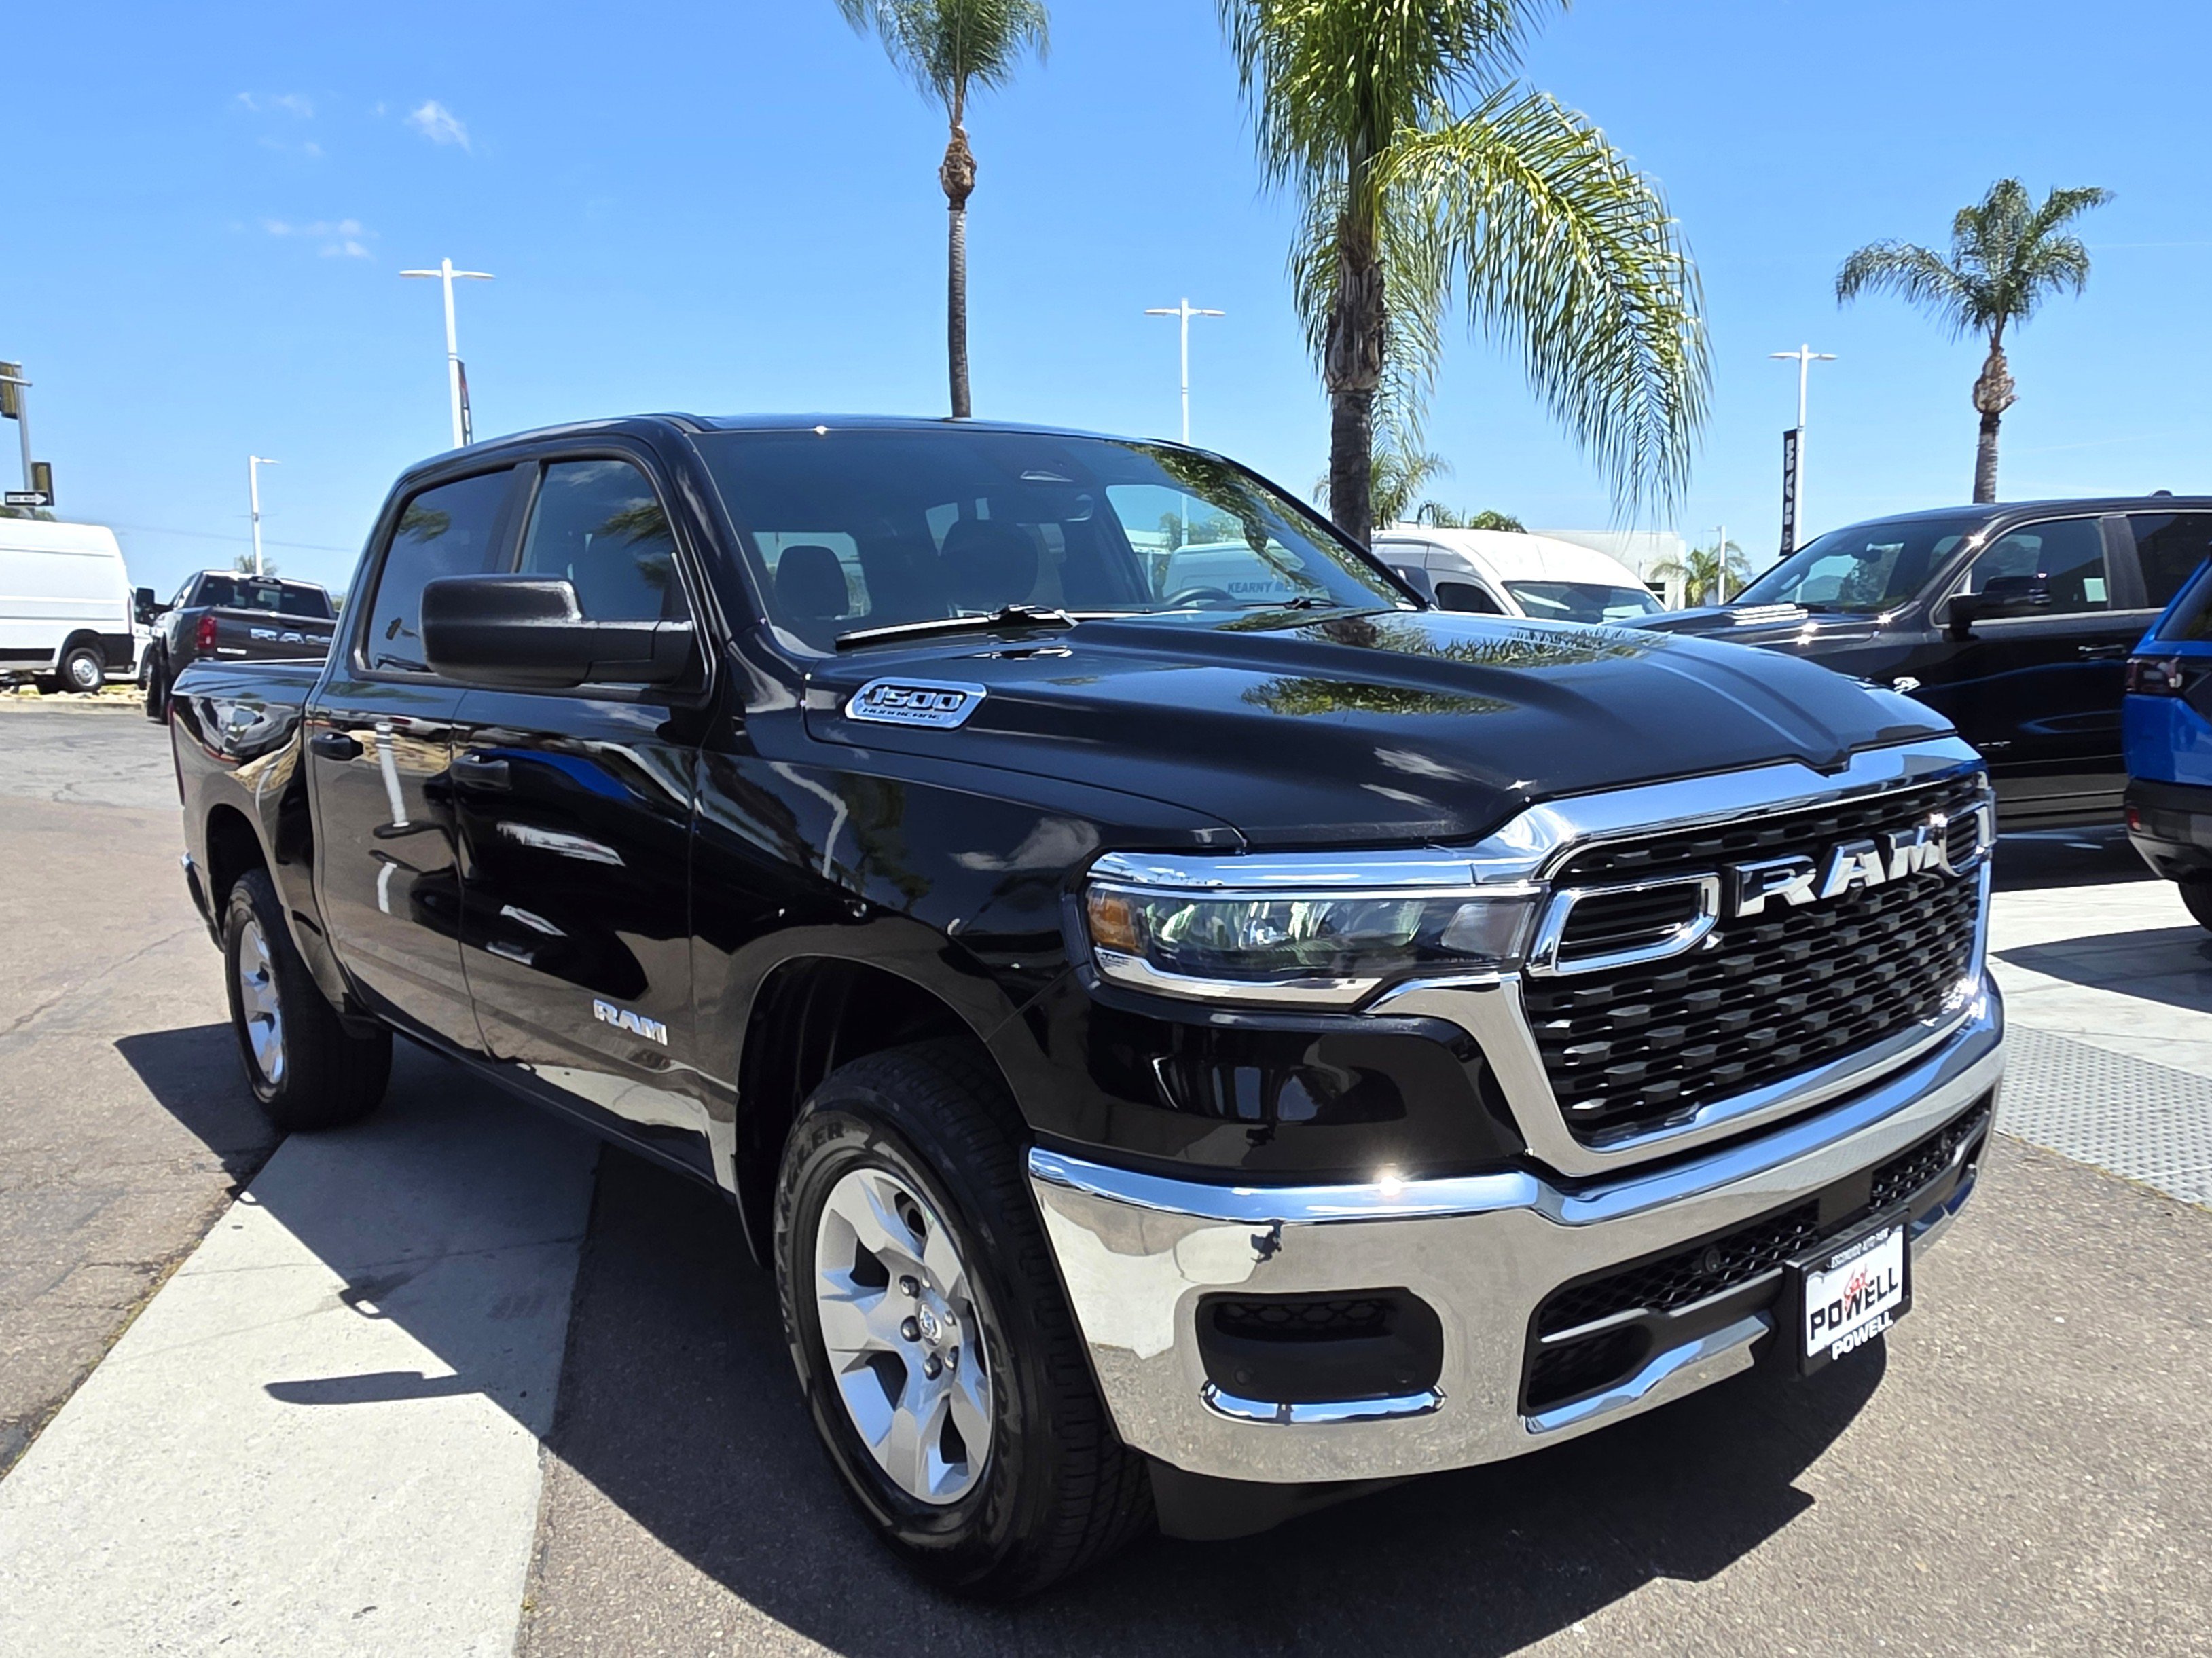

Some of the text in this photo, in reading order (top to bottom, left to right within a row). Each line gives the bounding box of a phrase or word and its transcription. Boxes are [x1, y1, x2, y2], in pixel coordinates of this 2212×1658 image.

[1227, 581, 1273, 593] KEARNY
[869, 687, 963, 710] 1500
[1726, 817, 1946, 917] RAM
[593, 999, 668, 1046] RAM
[1810, 1268, 1898, 1340] POWELL
[1832, 1311, 1893, 1361] POWELL
